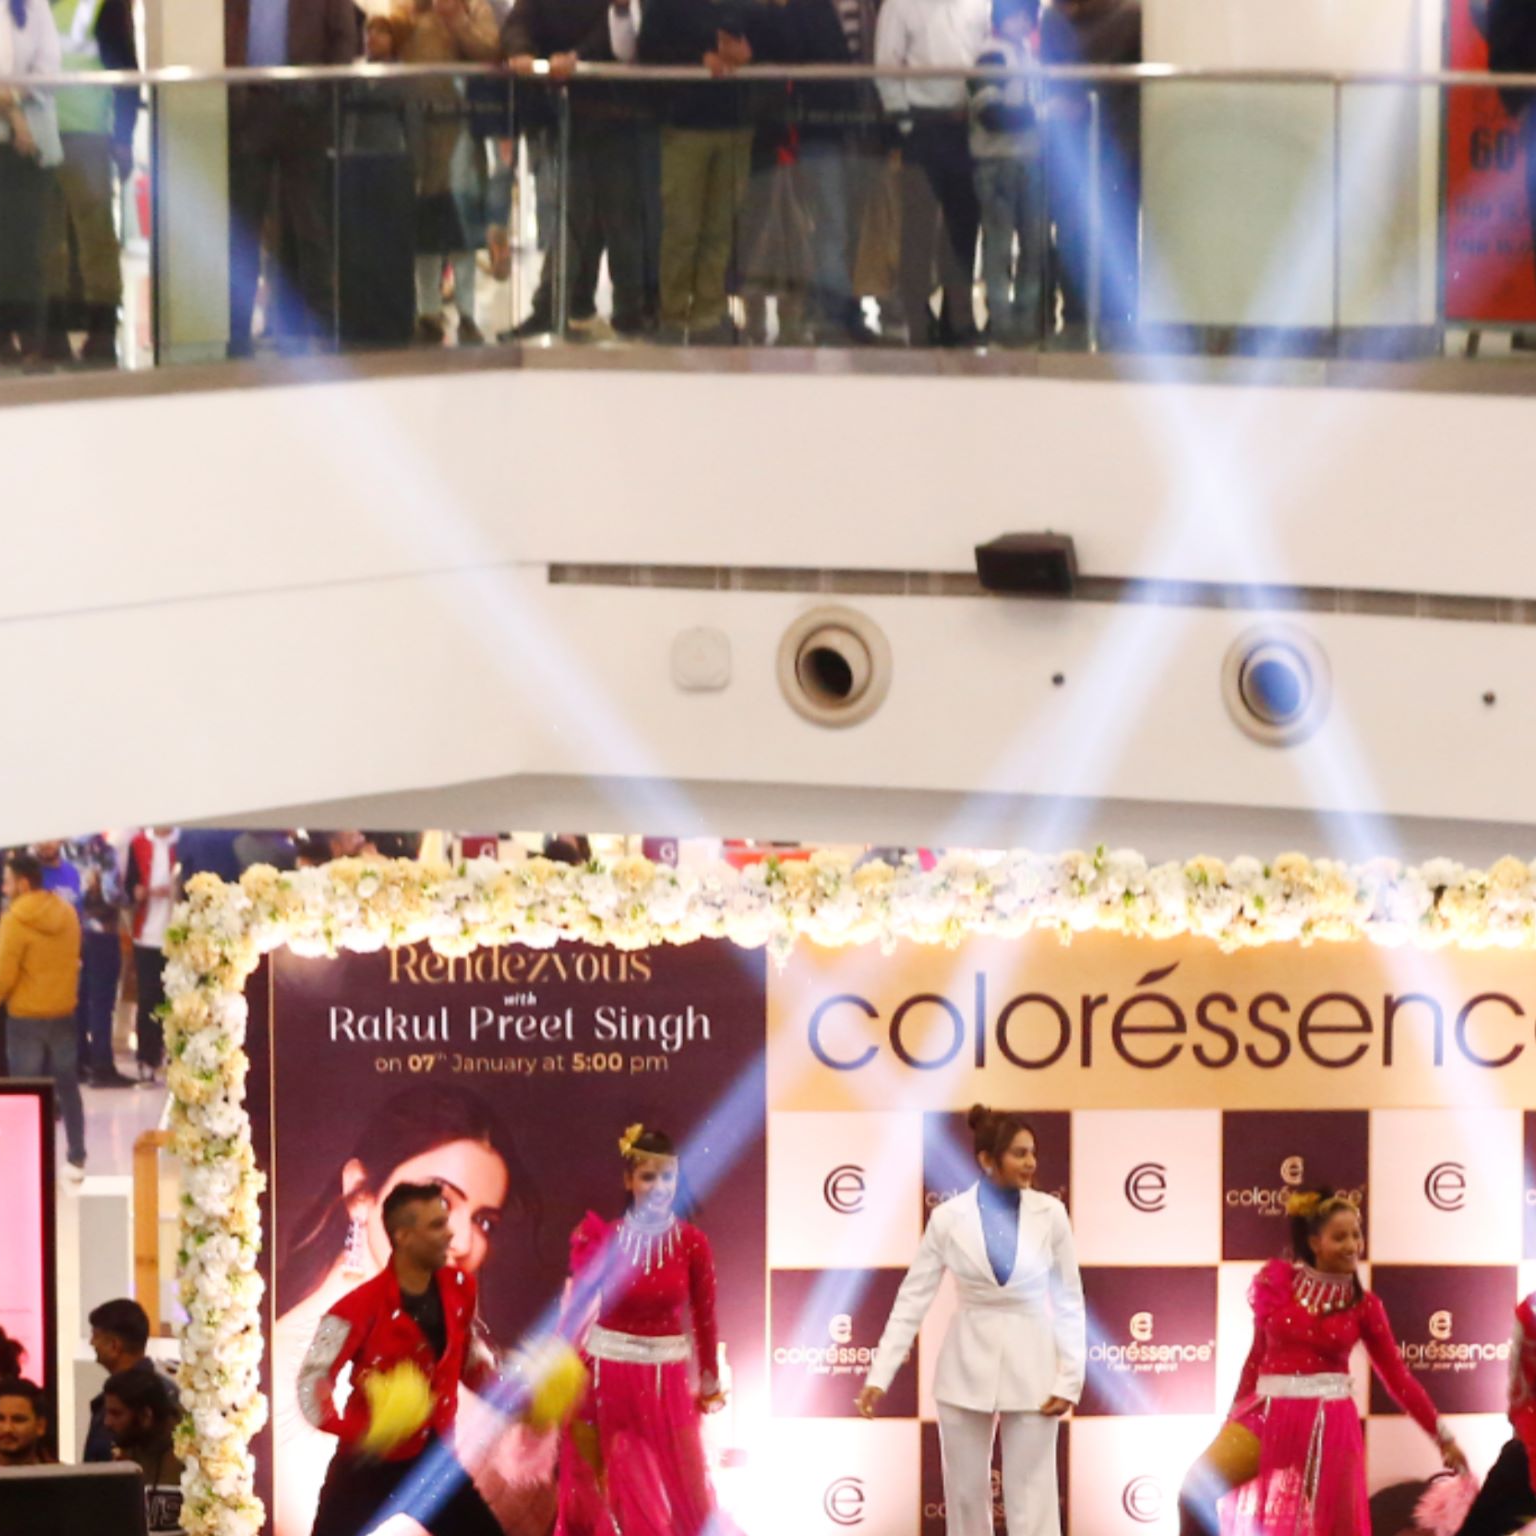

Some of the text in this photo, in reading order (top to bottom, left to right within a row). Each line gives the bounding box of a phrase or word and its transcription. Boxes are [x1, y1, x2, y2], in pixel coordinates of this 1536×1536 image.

[388, 945, 652, 984] Rendezvous
[503, 991, 537, 1006] with
[330, 1006, 711, 1051] Rakul Preet Singh
[375, 1057, 402, 1073] on
[452, 1053, 537, 1075] January
[543, 1055, 566, 1073] at
[572, 1053, 623, 1073] 5:00
[630, 1057, 668, 1075] pm
[1086, 1341, 1213, 1362] oloréssence
[1400, 1340, 1510, 1361] loréssence
